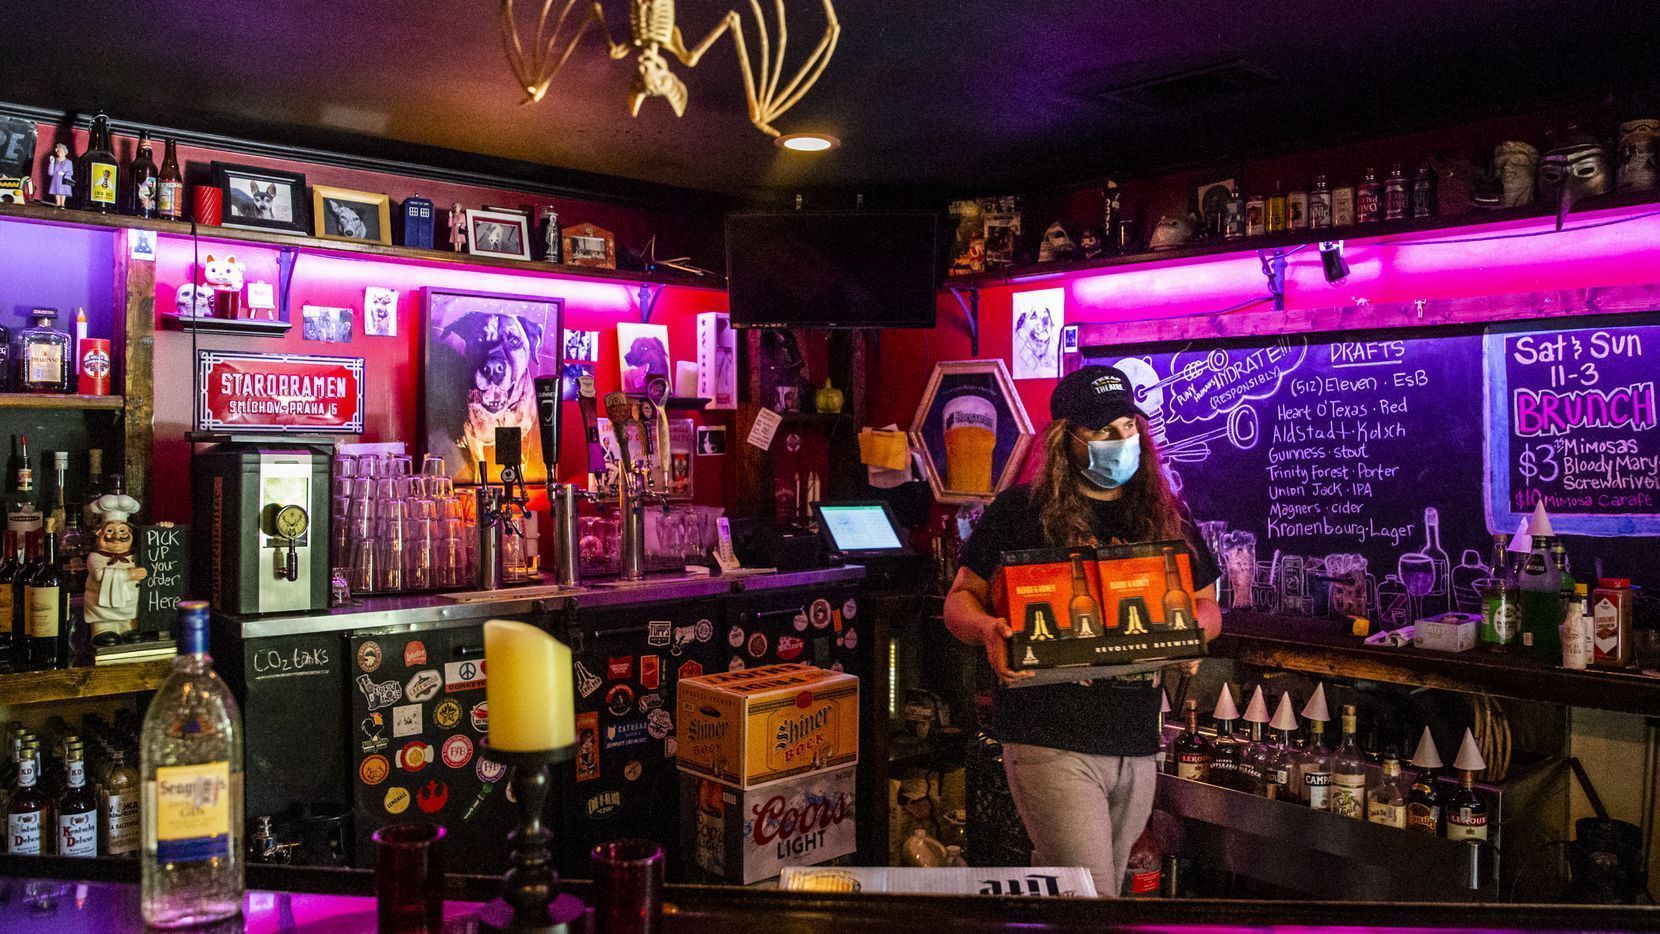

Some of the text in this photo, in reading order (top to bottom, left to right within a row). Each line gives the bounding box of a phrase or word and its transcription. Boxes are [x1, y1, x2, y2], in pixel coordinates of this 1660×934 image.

[1330, 340, 1405, 363] DRAFTS
[1513, 334, 1567, 365] Sat
[1590, 331, 1642, 359] Sun
[220, 372, 347, 399] STAROPRAMEN
[1551, 362, 1600, 387] 11-3
[1277, 403, 1312, 420] Heart
[1379, 396, 1408, 415] Red
[1515, 383, 1656, 437] BRUNCH
[1268, 446, 1327, 464] Guinness
[1564, 438, 1638, 456] Mimosas
[1265, 462, 1400, 485] Trinity Forest Porter
[1563, 454, 1613, 481] Bloody
[1269, 485, 1306, 500] Union
[1352, 482, 1373, 498] IPA
[1269, 502, 1321, 520] Magners
[147, 529, 180, 546] PICK
[1370, 517, 1415, 547] Lager
[148, 546, 170, 562] UP
[151, 560, 178, 577] your
[147, 574, 181, 588] order
[148, 590, 181, 613] Here
[1095, 643, 1148, 653] REVOLVER
[774, 705, 832, 753] Shiner
[784, 733, 824, 764] BOCK
[109, 801, 139, 813] VDKA
[752, 791, 849, 846] Coors
[62, 824, 95, 838] Kentucky
[67, 836, 94, 848] Deluxe
[777, 829, 826, 860] LIGHT
